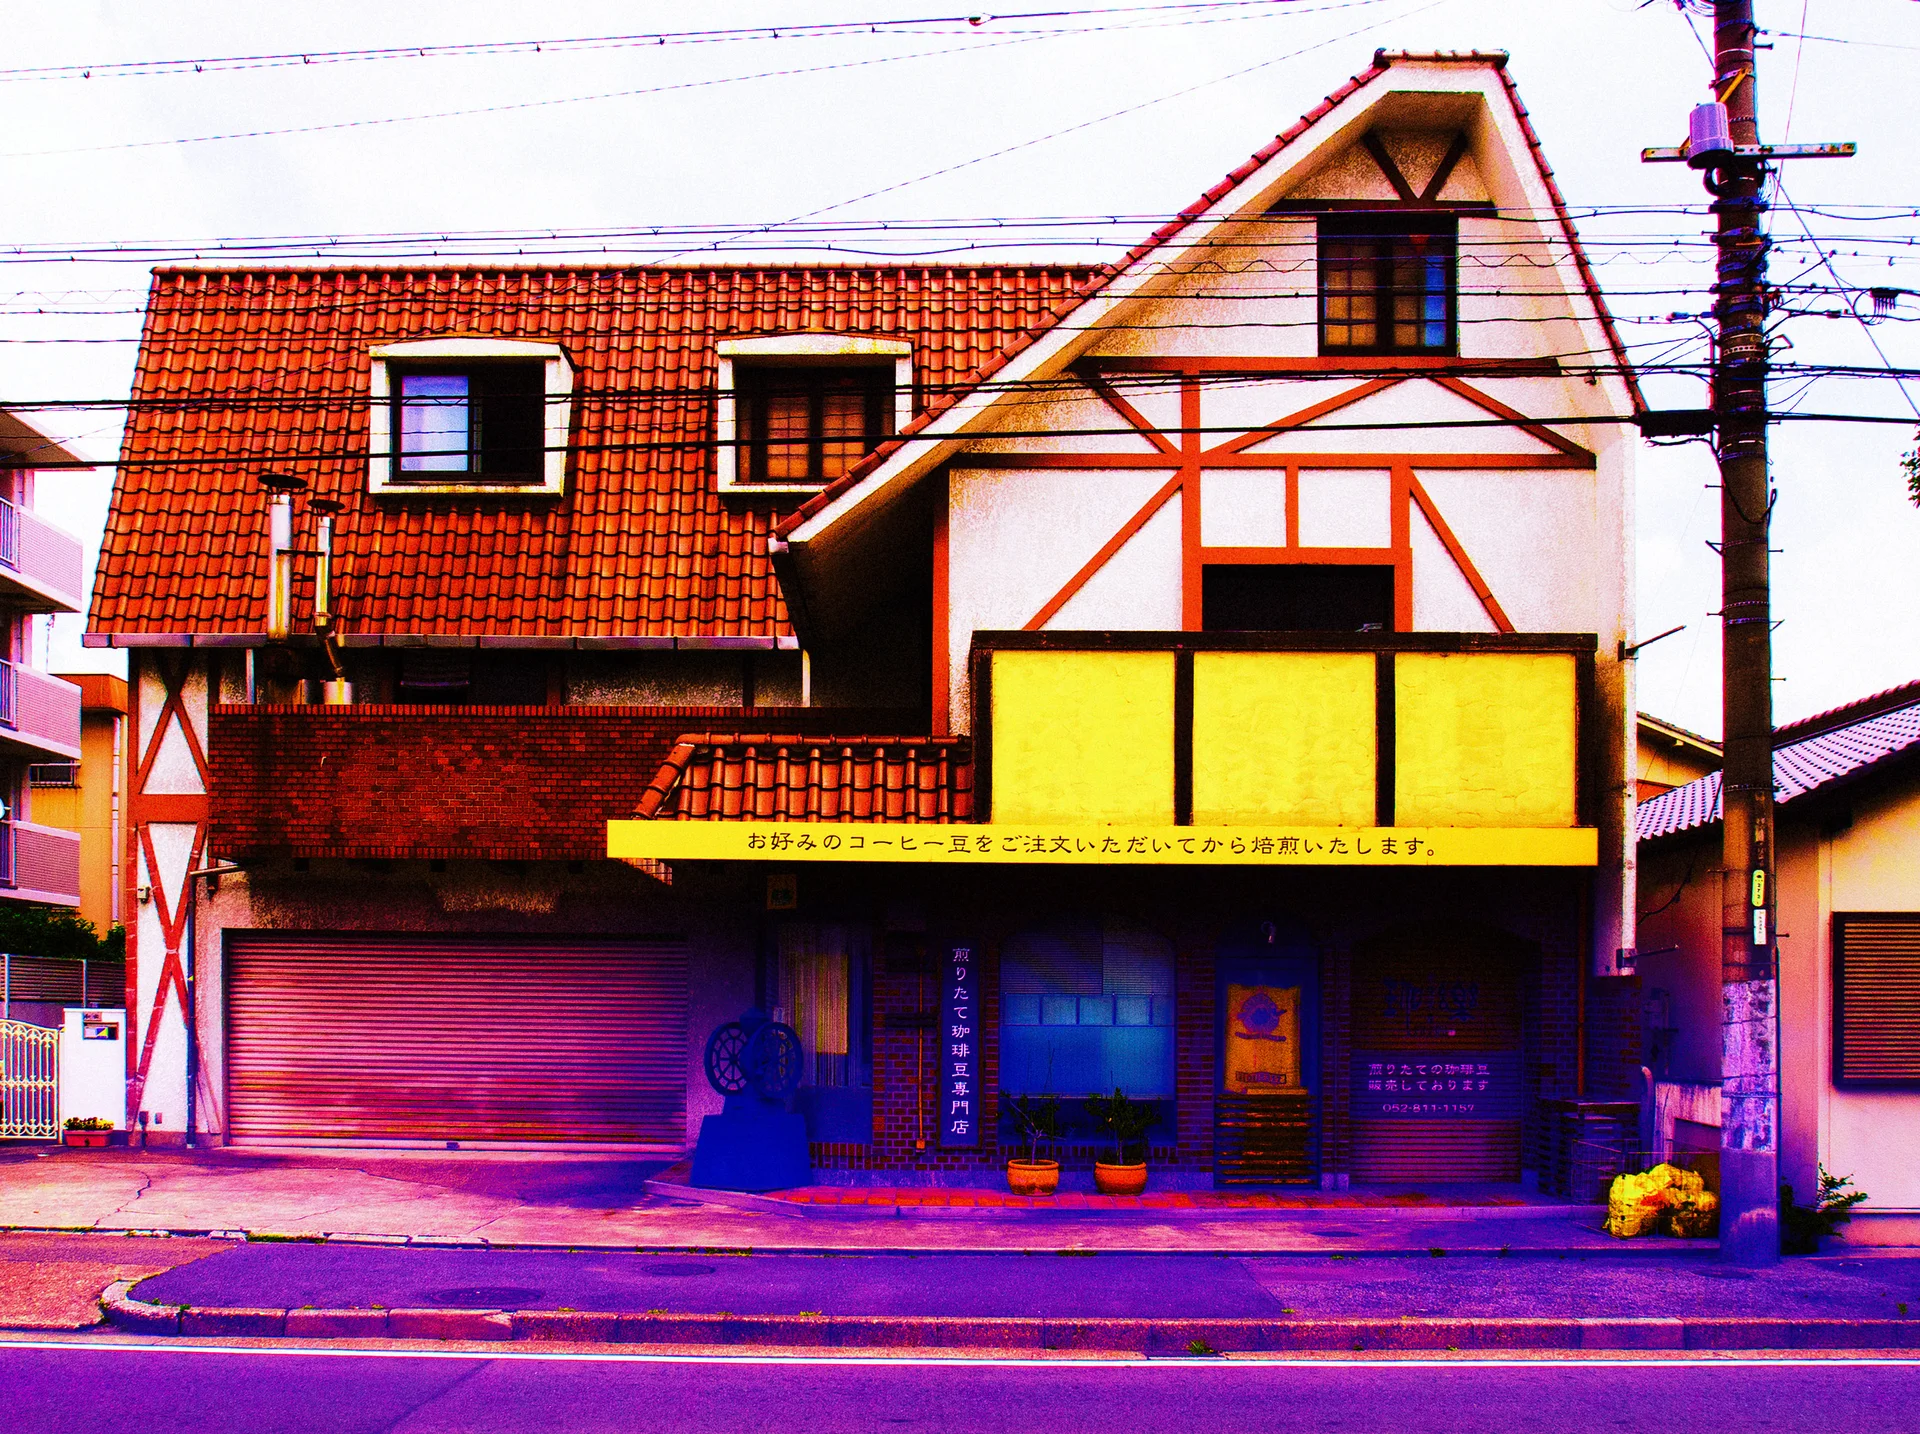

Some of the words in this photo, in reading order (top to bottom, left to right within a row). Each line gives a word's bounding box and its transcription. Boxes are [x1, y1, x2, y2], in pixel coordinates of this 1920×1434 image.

[747, 831, 1435, 857] お好みのコーヒー豆をご注文いただいてから焙煎いたします。
[951, 947, 971, 1135] 煎りたて珈琲豆専門店
[1368, 1063, 1490, 1076] 煎りたての珈琲豆
[1368, 1079, 1489, 1092] 販売しております
[1382, 1103, 1475, 1113] 052-811-1157
